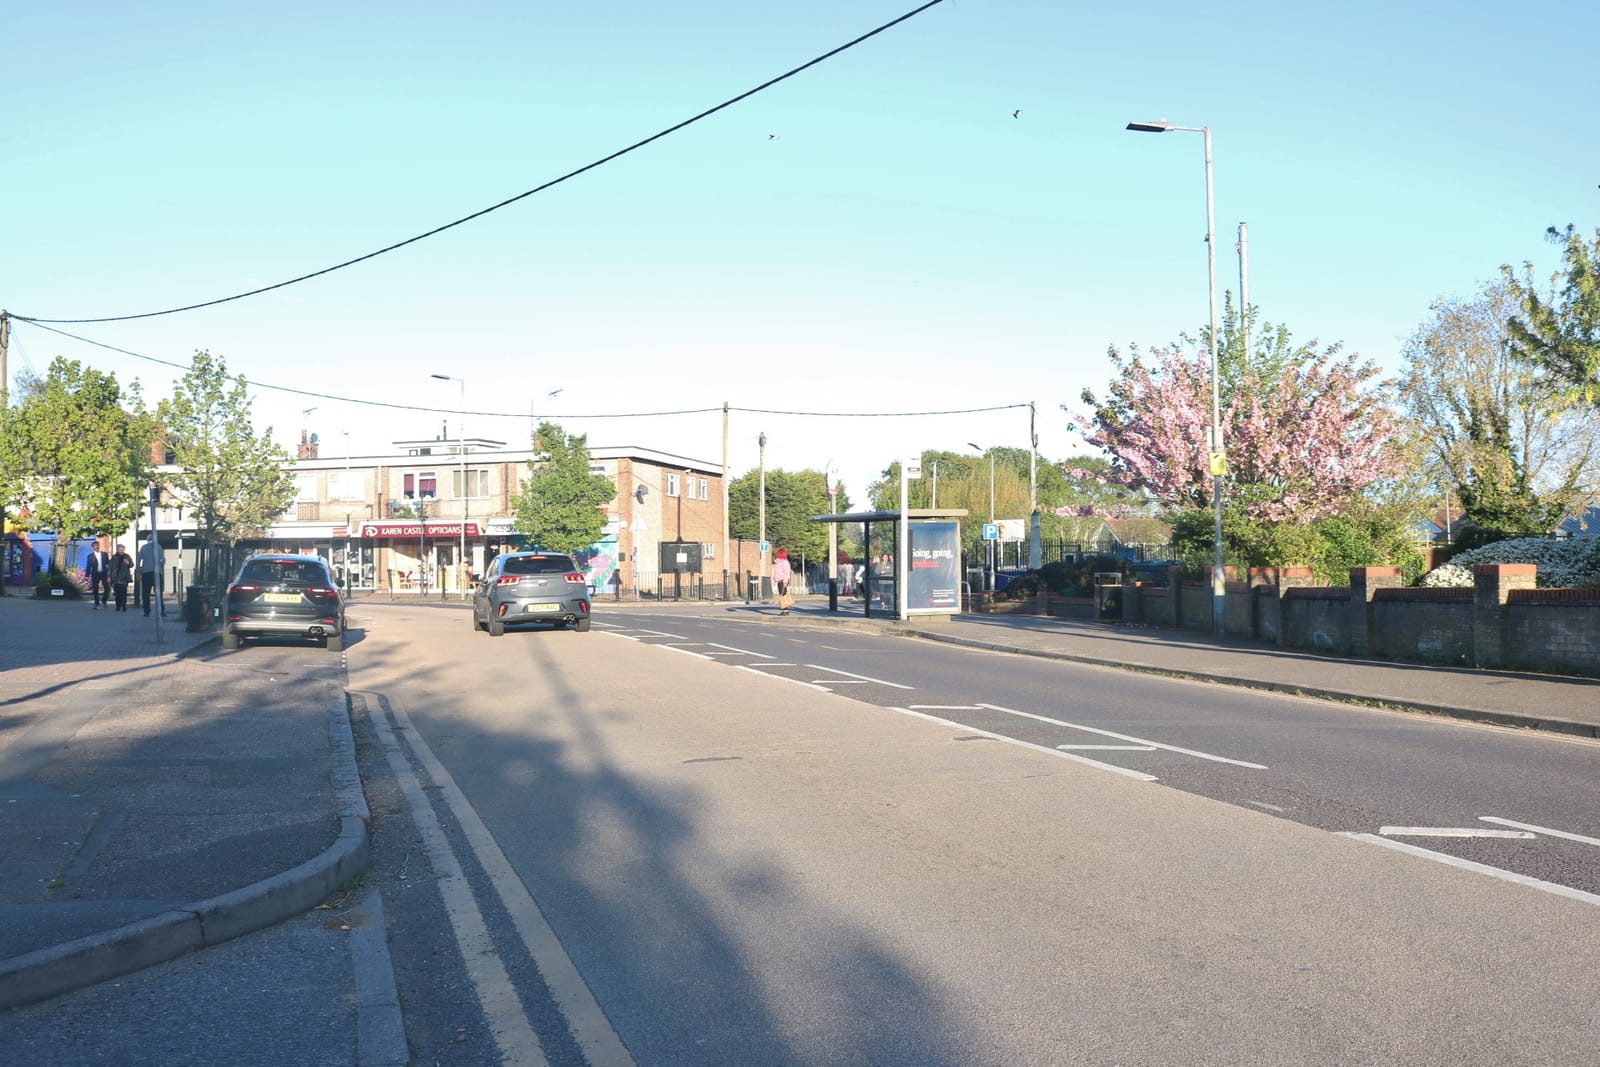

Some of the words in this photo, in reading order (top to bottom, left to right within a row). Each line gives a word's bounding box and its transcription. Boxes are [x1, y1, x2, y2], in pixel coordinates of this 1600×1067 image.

[381, 527, 402, 535] KAREN
[428, 526, 462, 535] OPTICIANS
[986, 525, 996, 538] P
[912, 548, 931, 560] oing,
